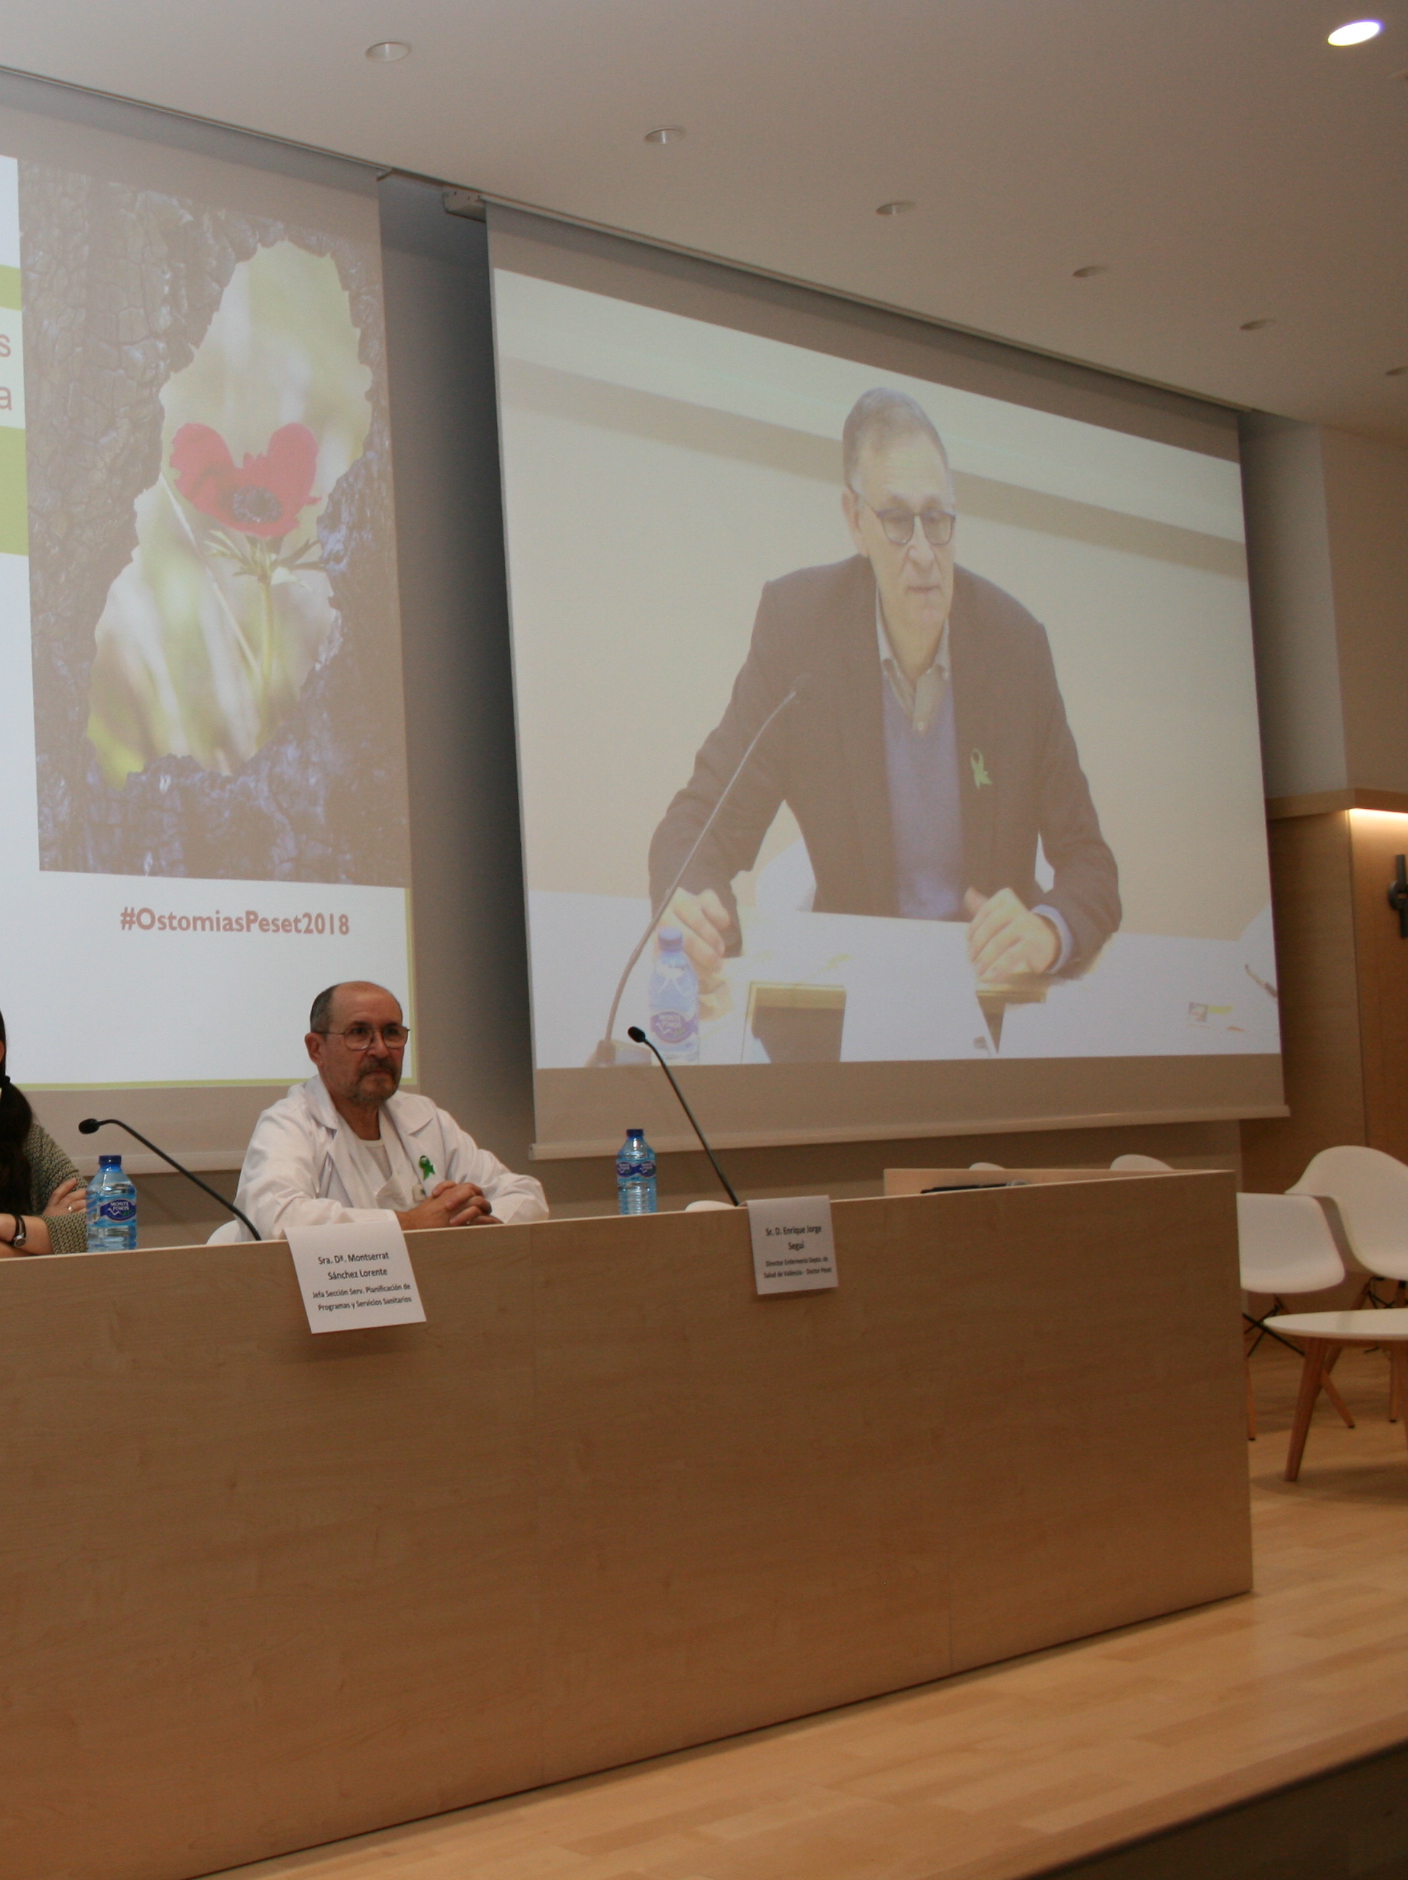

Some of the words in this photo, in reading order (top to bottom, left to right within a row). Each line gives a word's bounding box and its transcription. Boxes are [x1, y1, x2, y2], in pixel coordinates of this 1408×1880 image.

[120, 906, 350, 935] #OstomiasPeset2018
[317, 1256, 333, 1265] Sra.
[348, 1252, 390, 1262] Montserrat
[327, 1270, 359, 1280] Sánchez
[360, 1268, 388, 1278] Lorente
[317, 1303, 350, 1312] Programas
[356, 1299, 383, 1308] Servicios
[383, 1296, 412, 1305] Sanitarios
